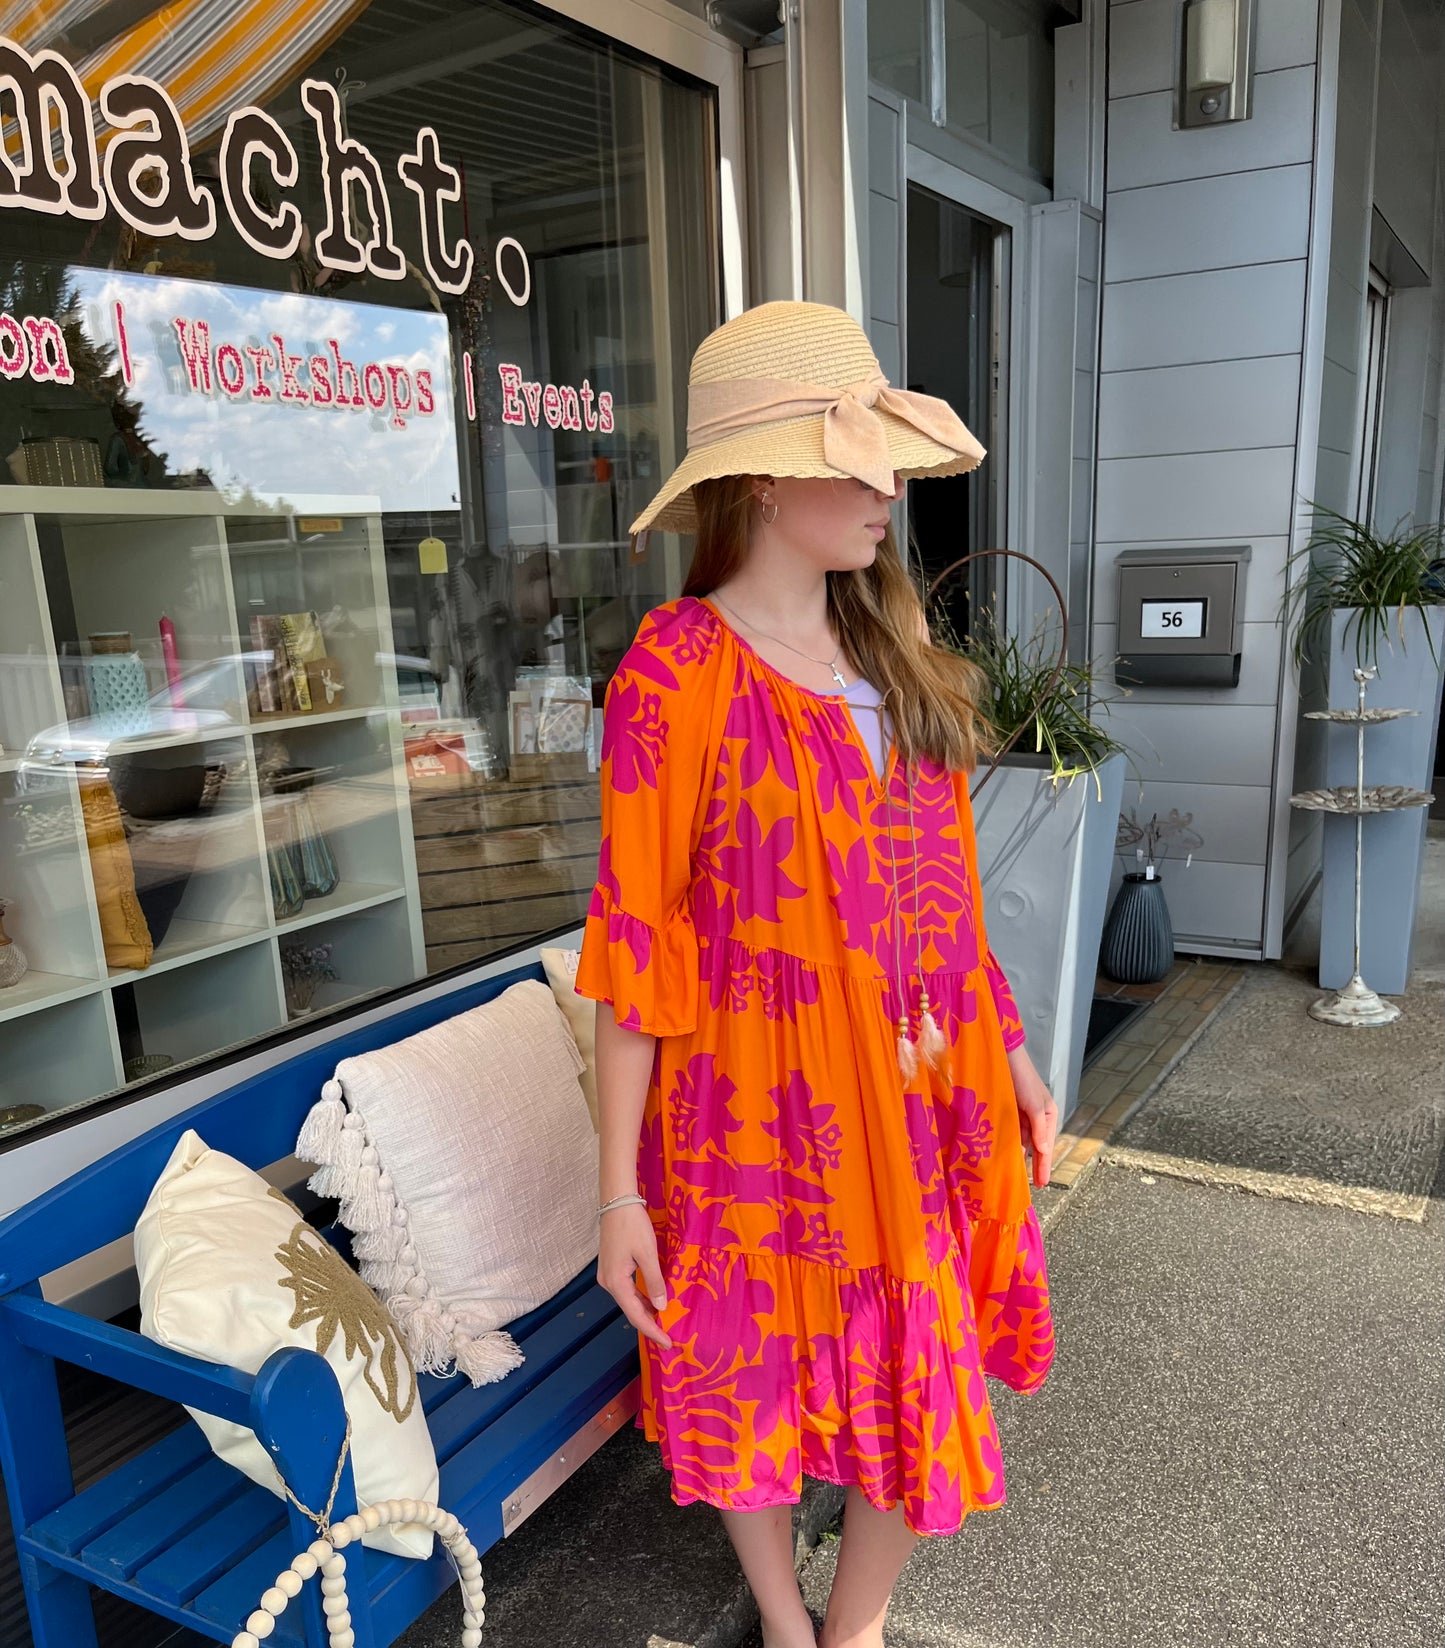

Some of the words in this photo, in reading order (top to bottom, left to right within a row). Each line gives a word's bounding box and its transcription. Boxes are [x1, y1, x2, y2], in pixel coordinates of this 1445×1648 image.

[0, 38, 531, 306] macht.
[173, 317, 436, 429] Workshops
[499, 363, 615, 433] Events
[1161, 611, 1183, 628] 56
